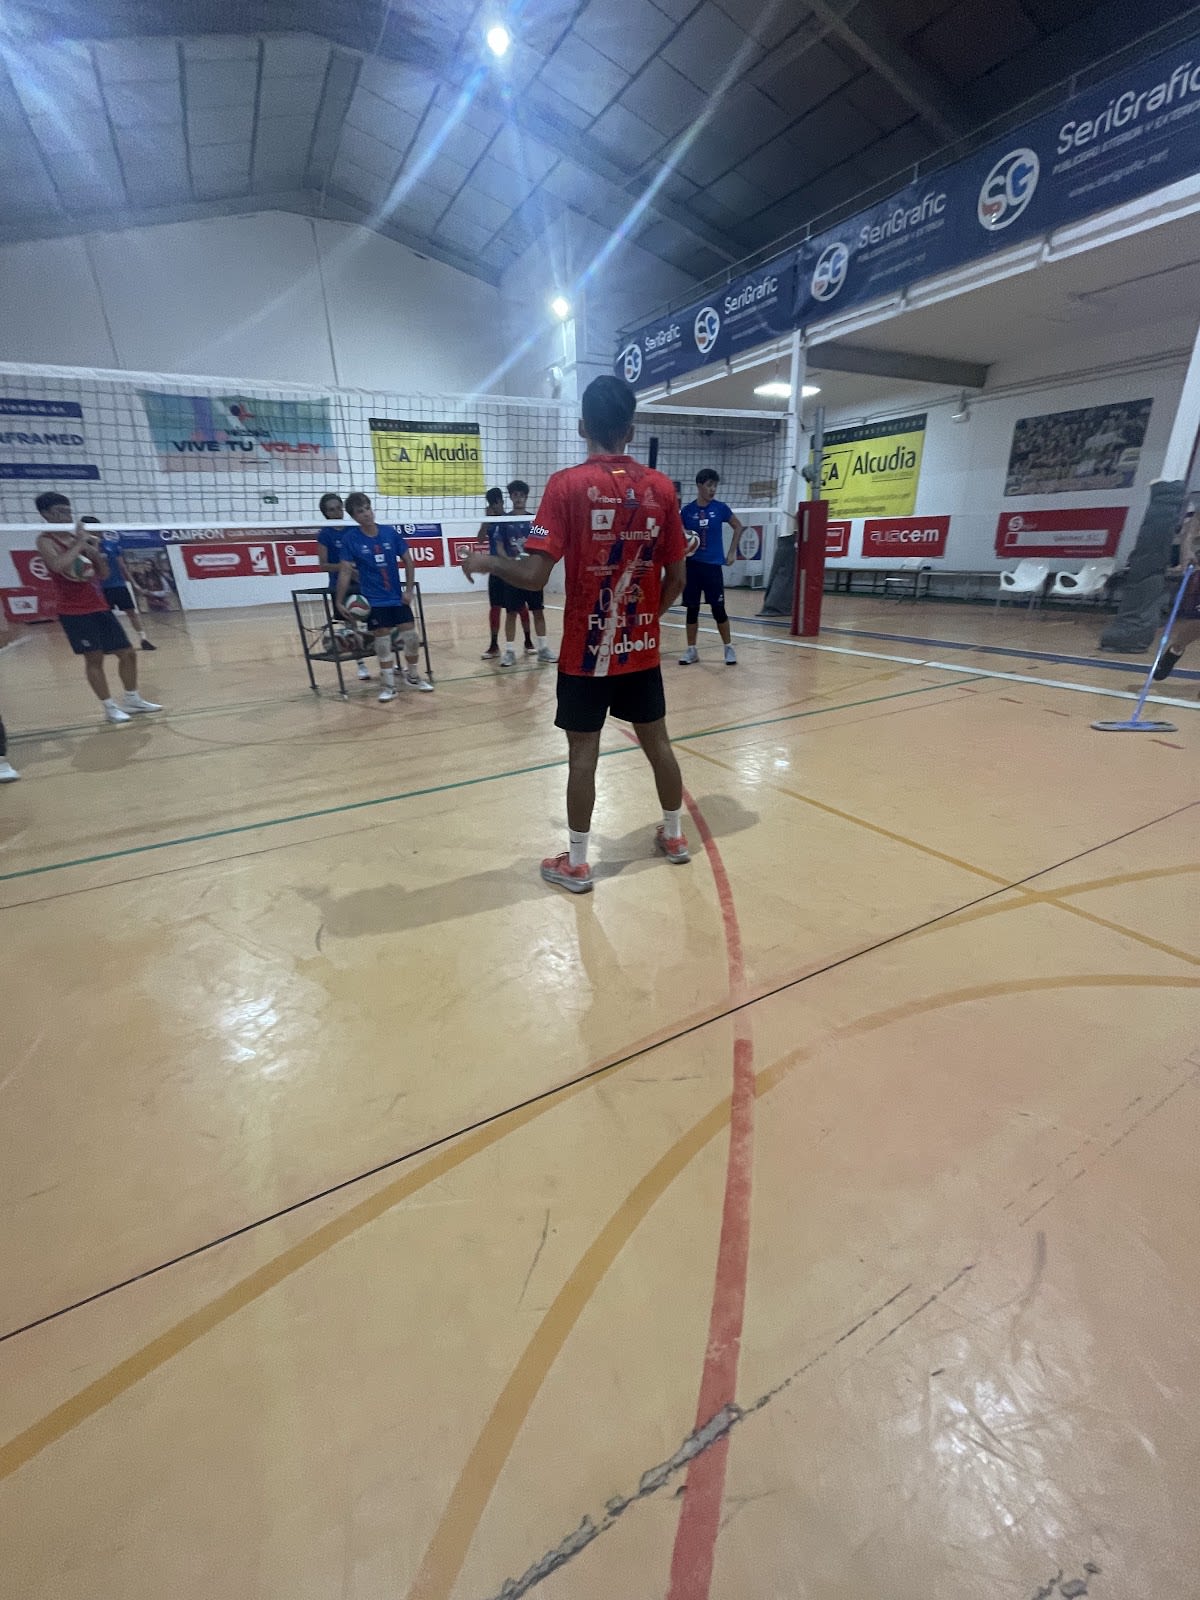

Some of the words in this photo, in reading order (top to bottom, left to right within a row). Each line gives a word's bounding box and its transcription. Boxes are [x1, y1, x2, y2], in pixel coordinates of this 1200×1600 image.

[858, 191, 947, 249] SeriGrafic
[724, 276, 778, 315] SeriGrafic
[645, 323, 681, 352] SeriGrafic
[172, 440, 221, 453] VIVE
[225, 440, 254, 452] TU
[260, 442, 322, 455] VOLEY
[423, 442, 479, 462] Alcudia
[852, 445, 917, 477] Alcudia
[619, 530, 652, 542] suma
[587, 631, 656, 658] volabola
